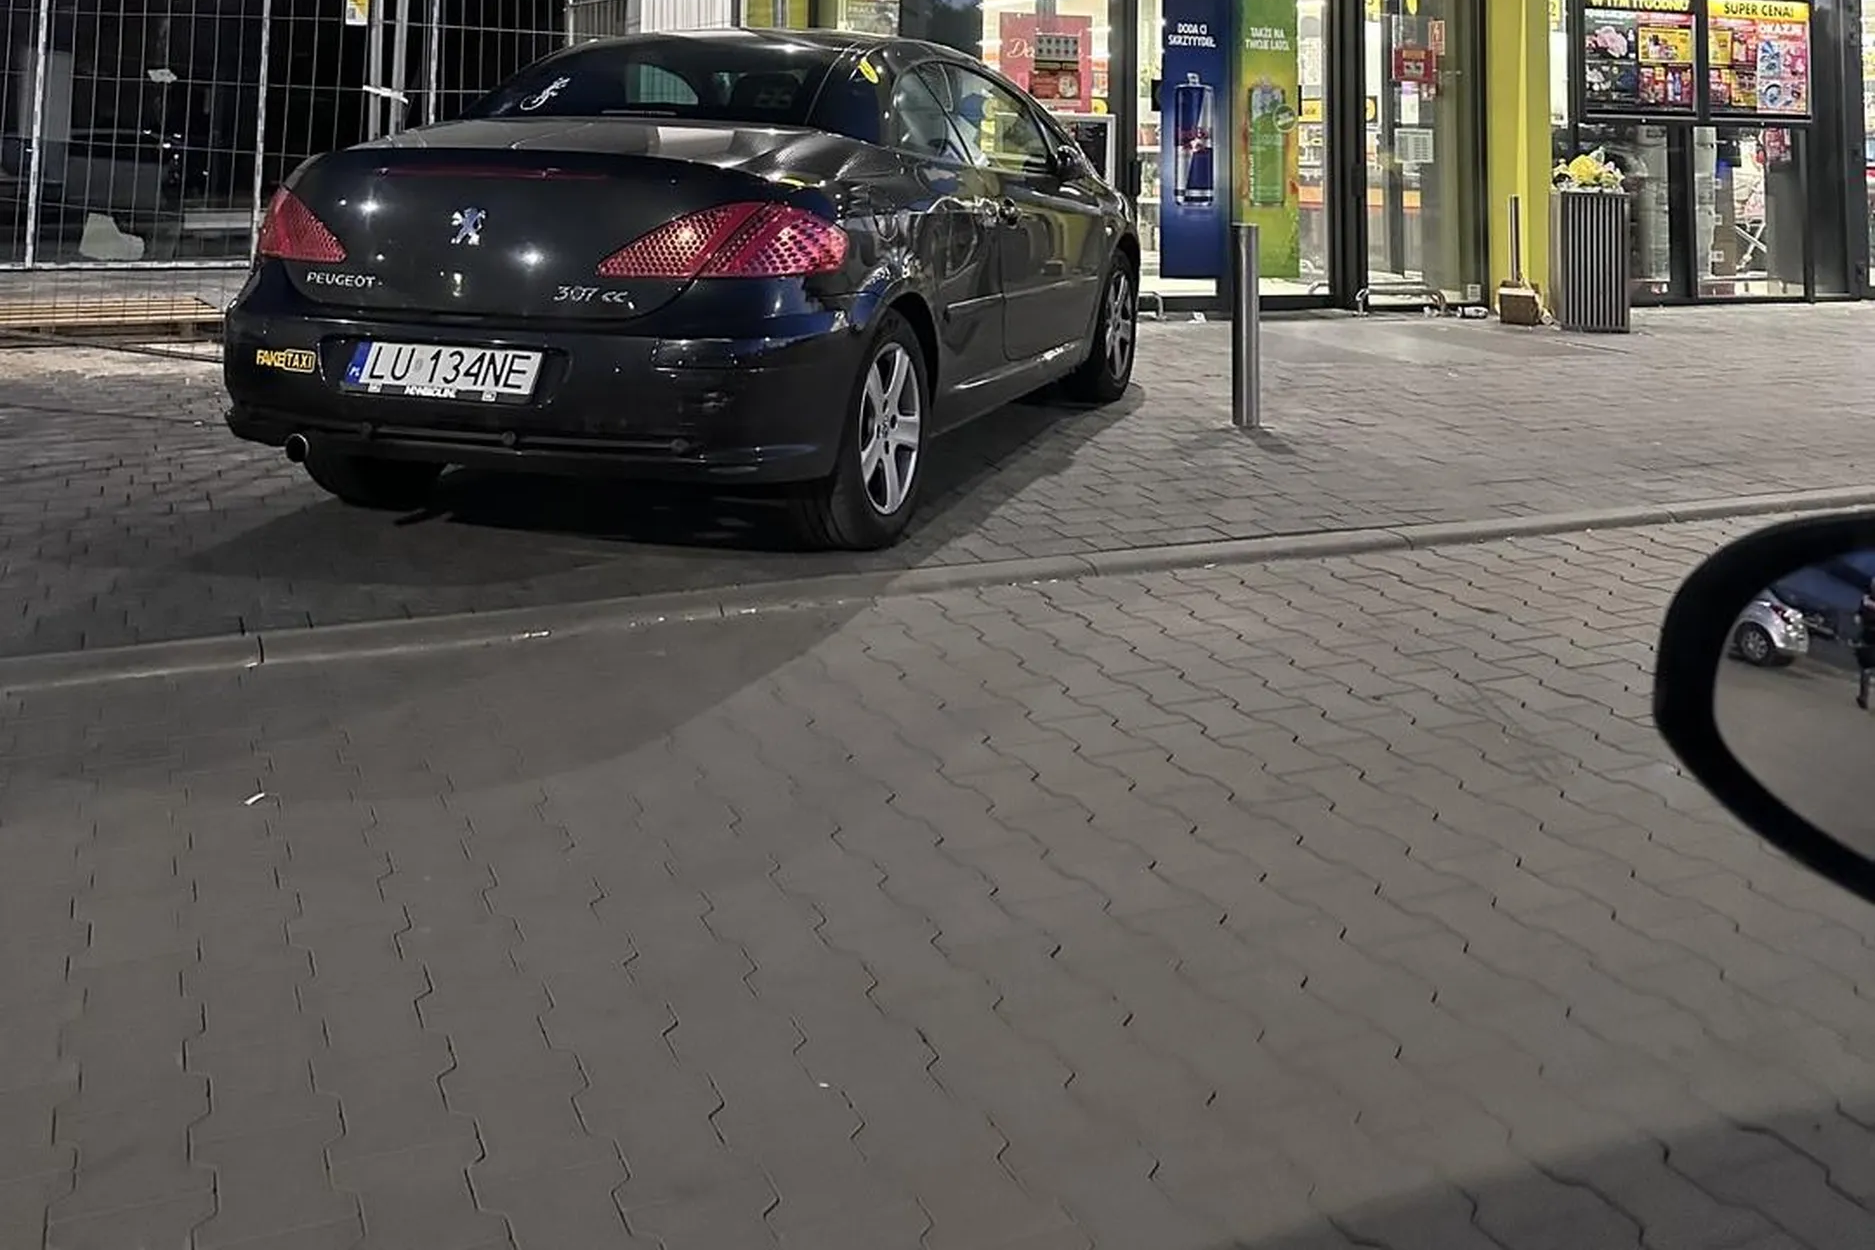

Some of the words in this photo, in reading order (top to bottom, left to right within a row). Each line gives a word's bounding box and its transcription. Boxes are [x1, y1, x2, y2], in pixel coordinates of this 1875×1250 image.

[1723, 1, 1758, 16] SUPER
[306, 271, 376, 289] PEUGEOT
[553, 285, 600, 302] 307
[369, 346, 416, 381] LU
[428, 349, 532, 389] 134NE
